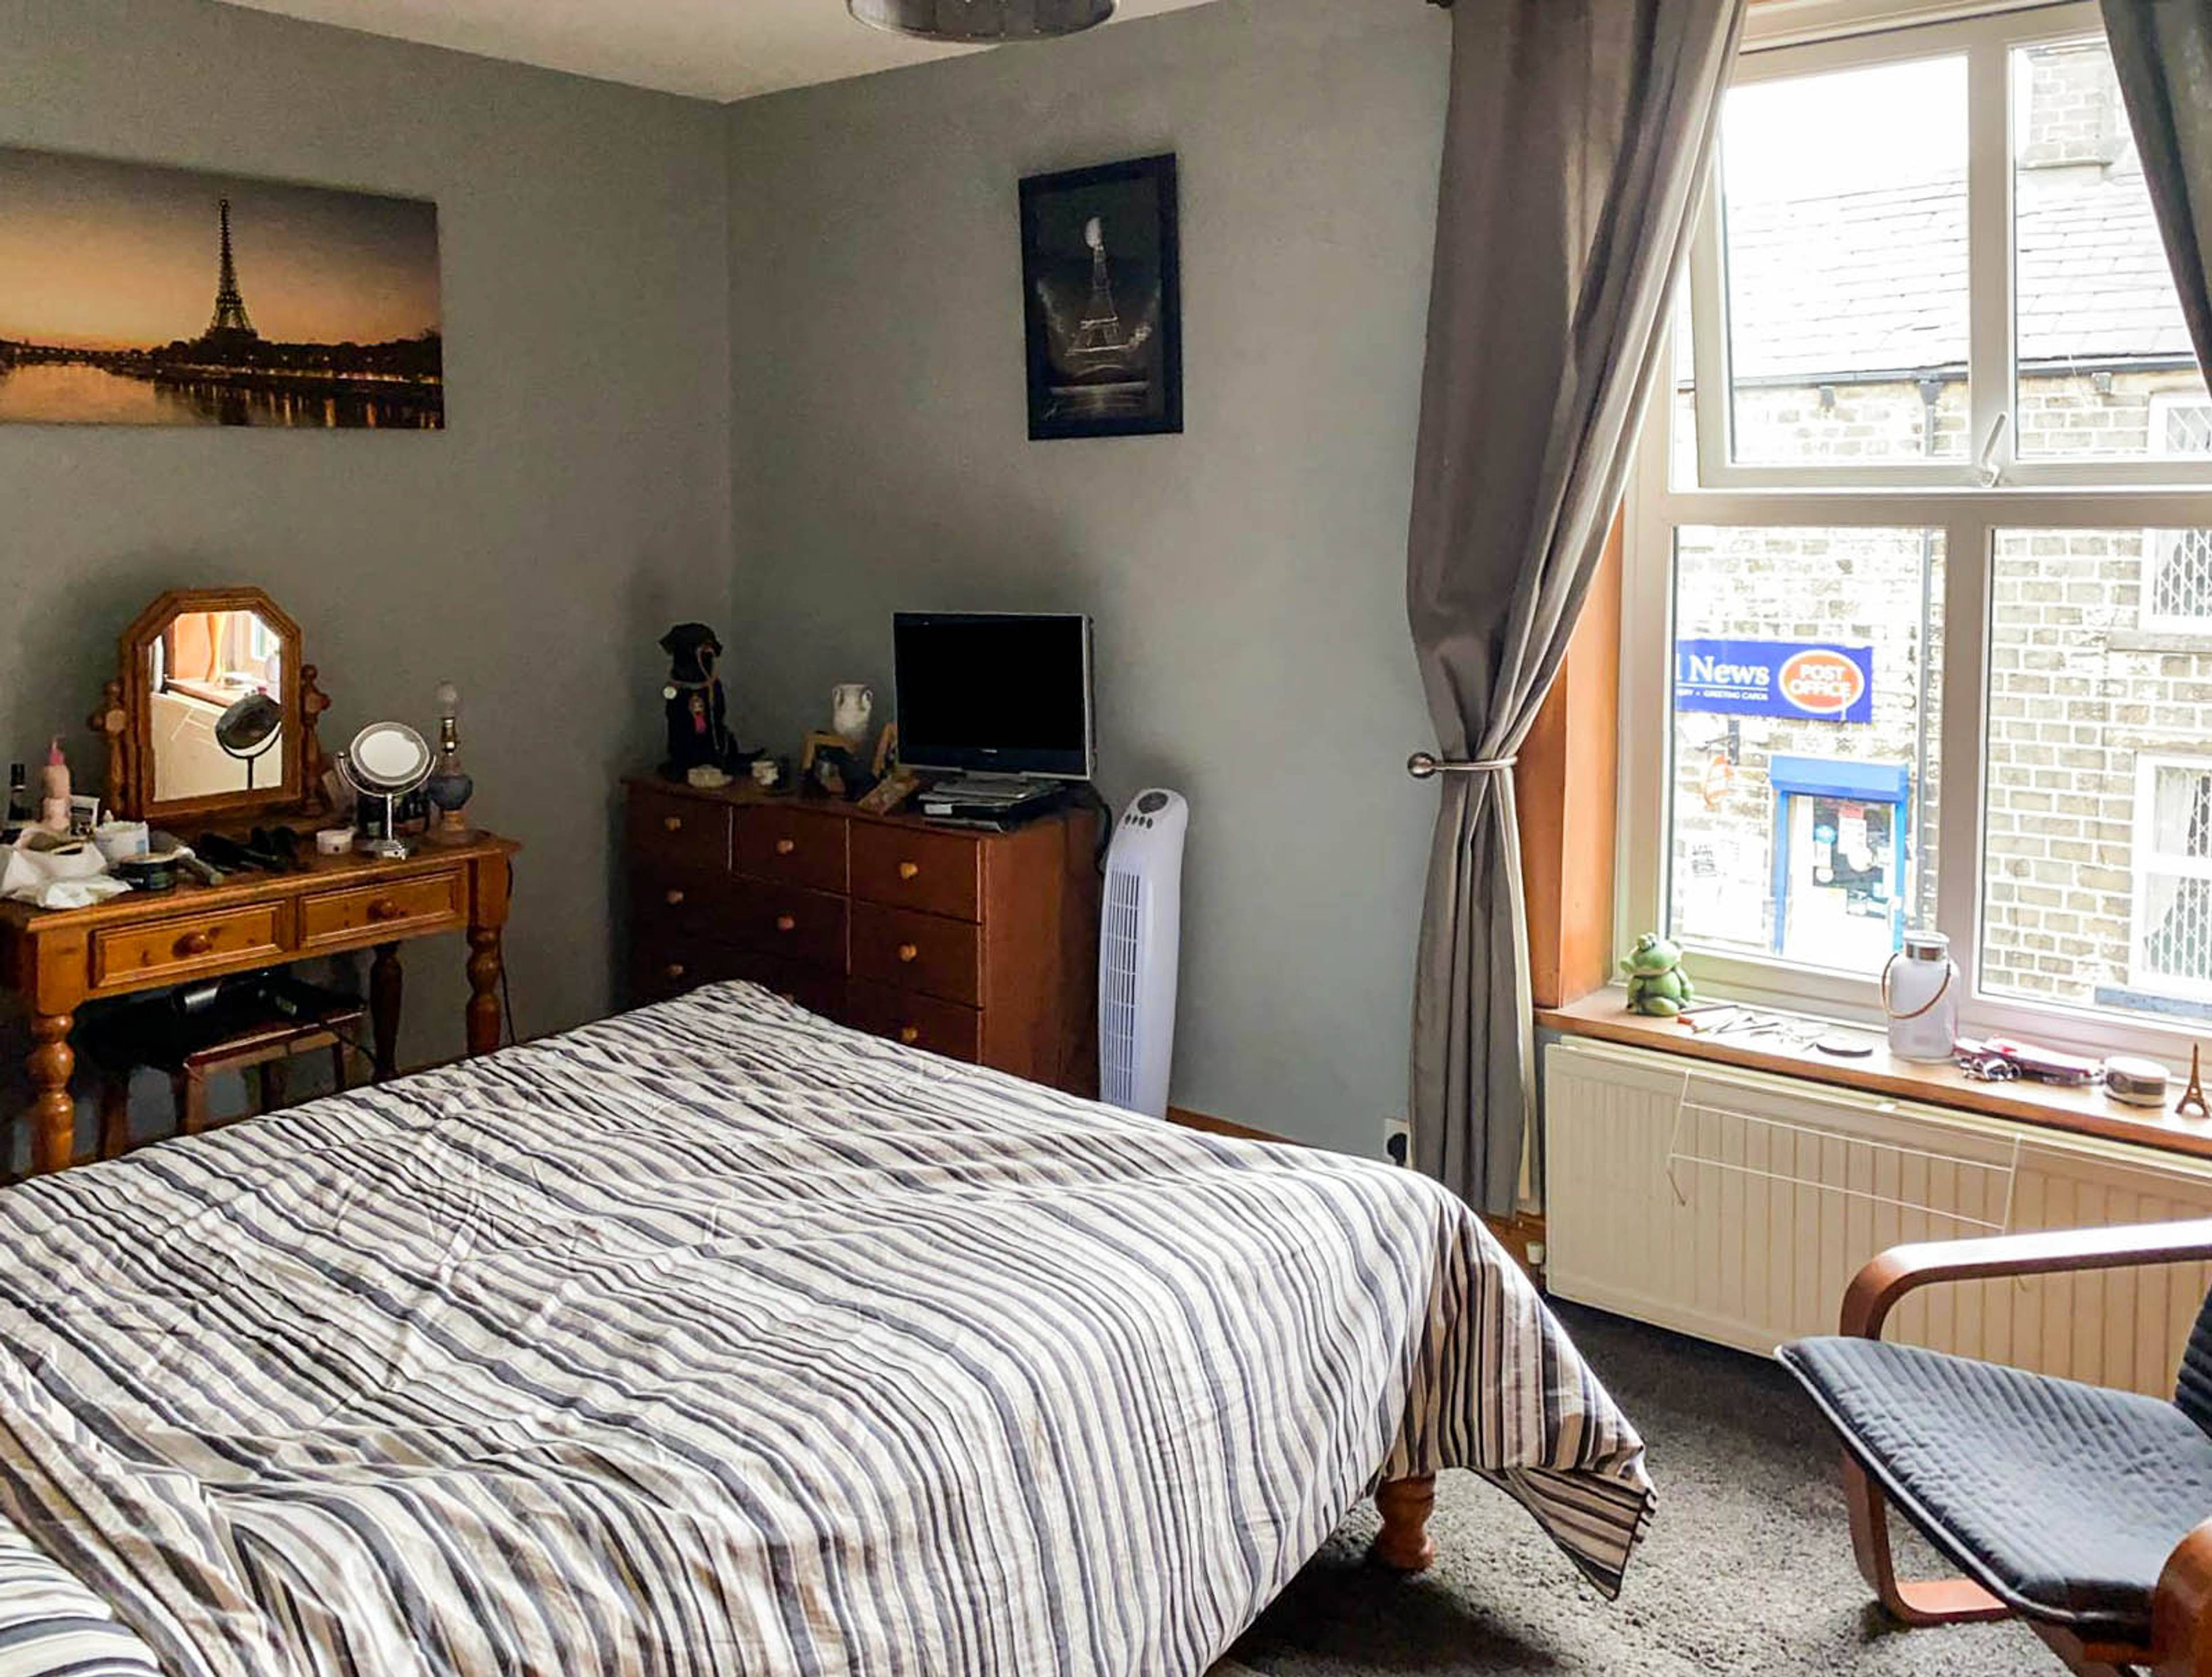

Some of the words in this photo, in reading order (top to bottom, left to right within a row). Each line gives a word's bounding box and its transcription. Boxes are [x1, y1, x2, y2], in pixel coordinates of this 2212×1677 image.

[1688, 654, 1770, 686] News
[1800, 664, 1846, 681] POST
[1790, 680, 1851, 697] OFFICE
